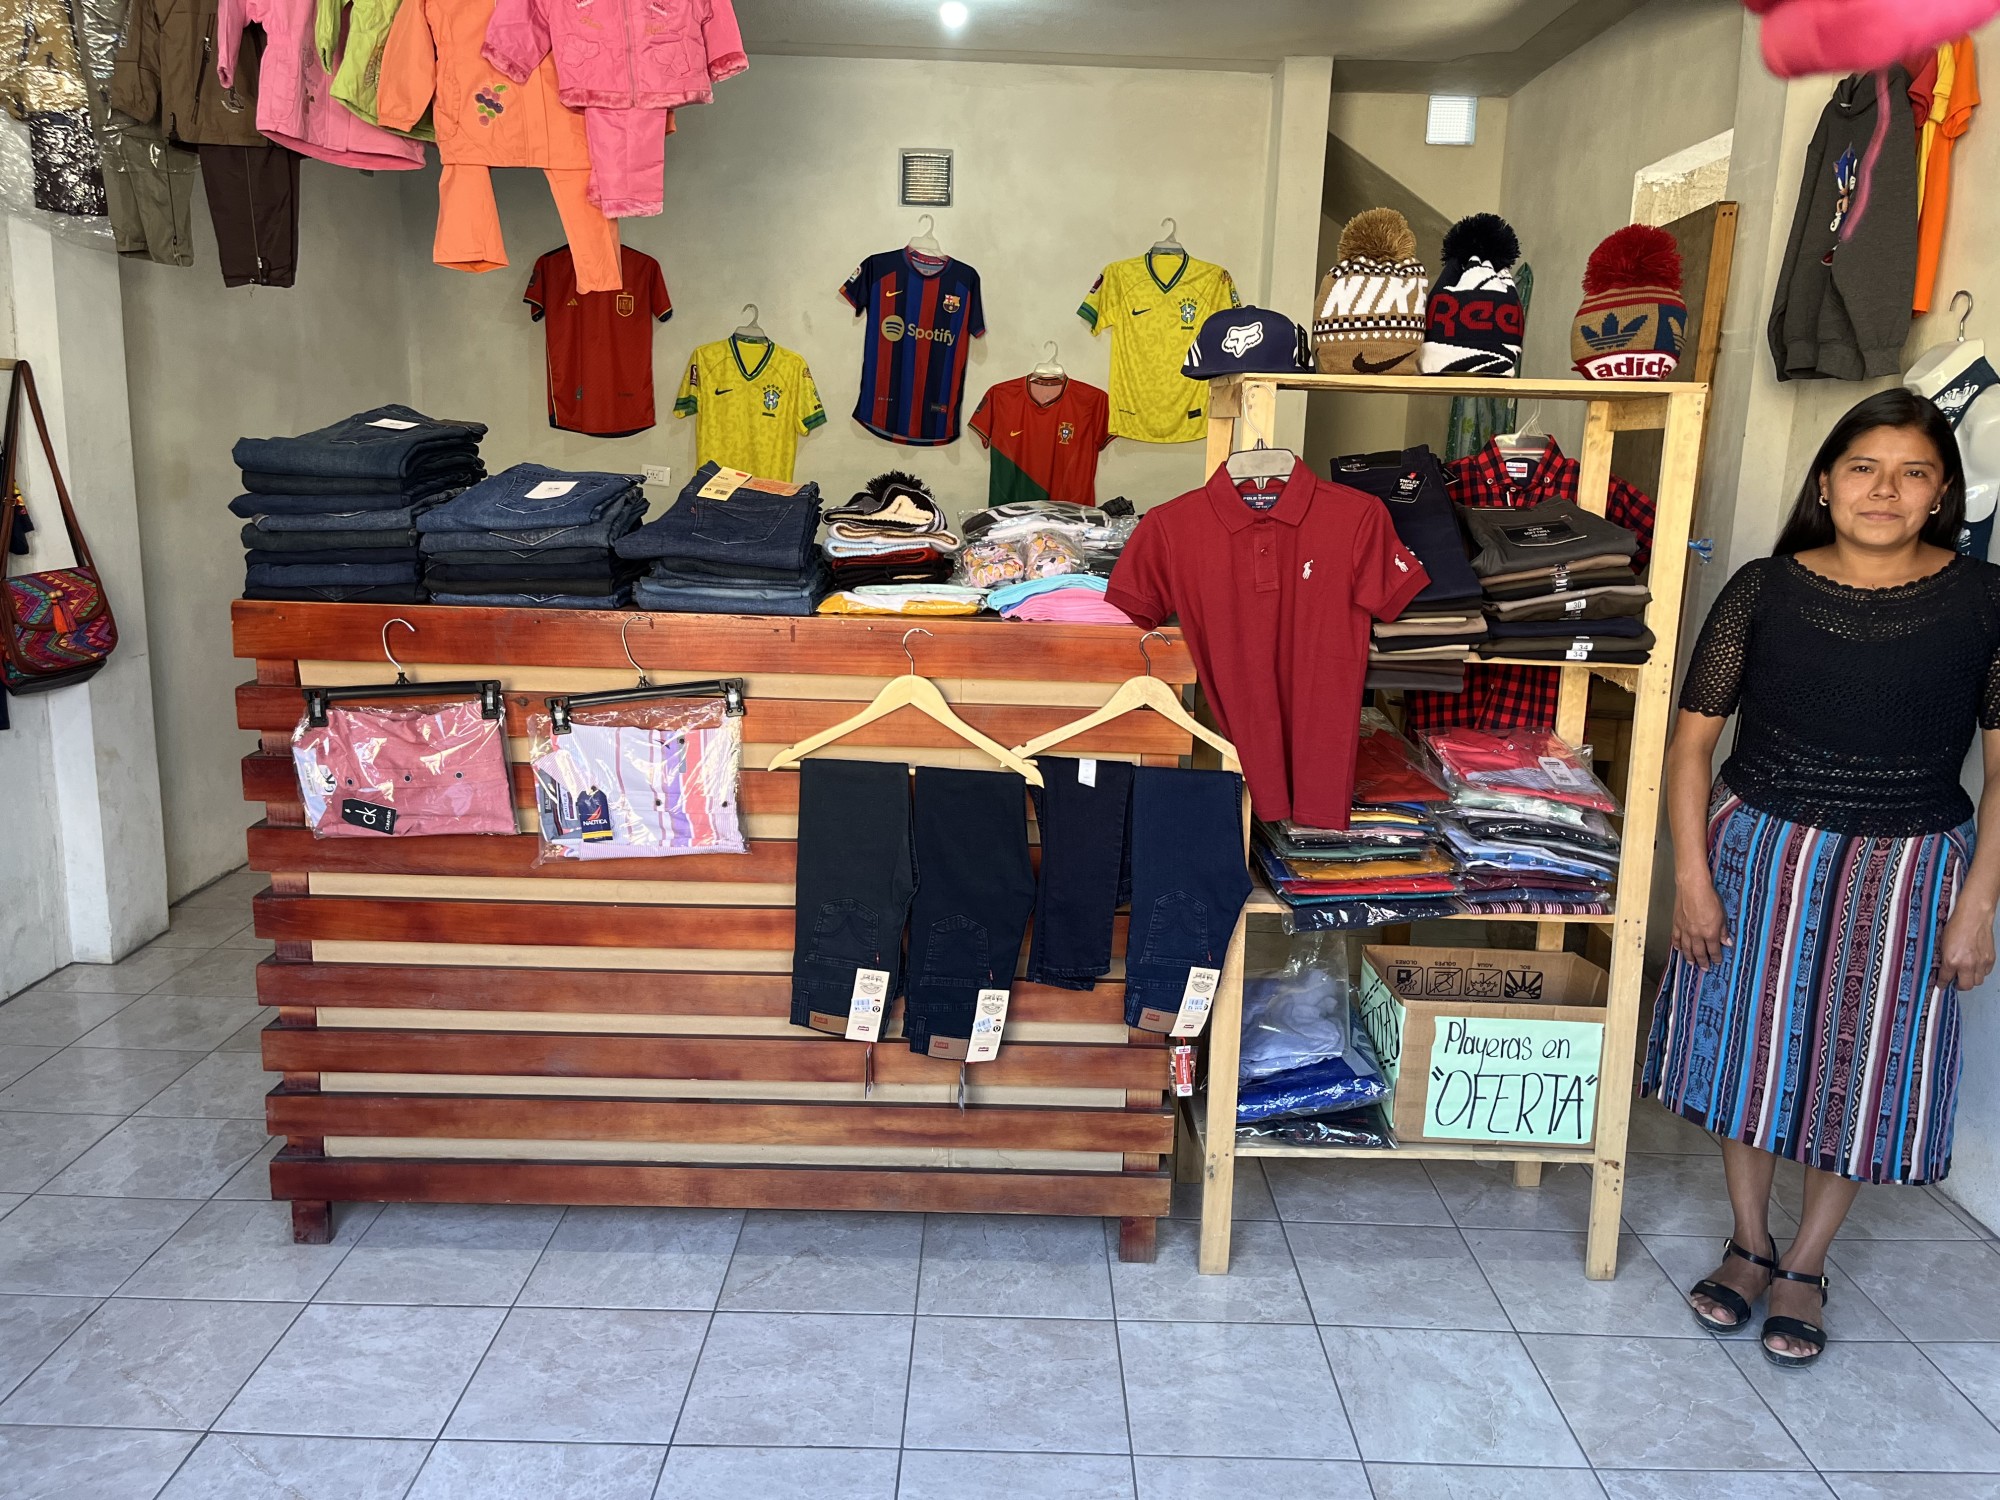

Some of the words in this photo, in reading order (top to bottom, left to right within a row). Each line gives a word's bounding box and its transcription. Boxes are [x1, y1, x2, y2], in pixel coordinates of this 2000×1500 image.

[1320, 275, 1428, 318] NIKE
[907, 323, 956, 346] Spotify
[1573, 601, 1582, 609] 30
[582, 818, 608, 826] NAUTICA
[1444, 1018, 1532, 1075] Playeras
[1542, 1038, 1570, 1059] en
